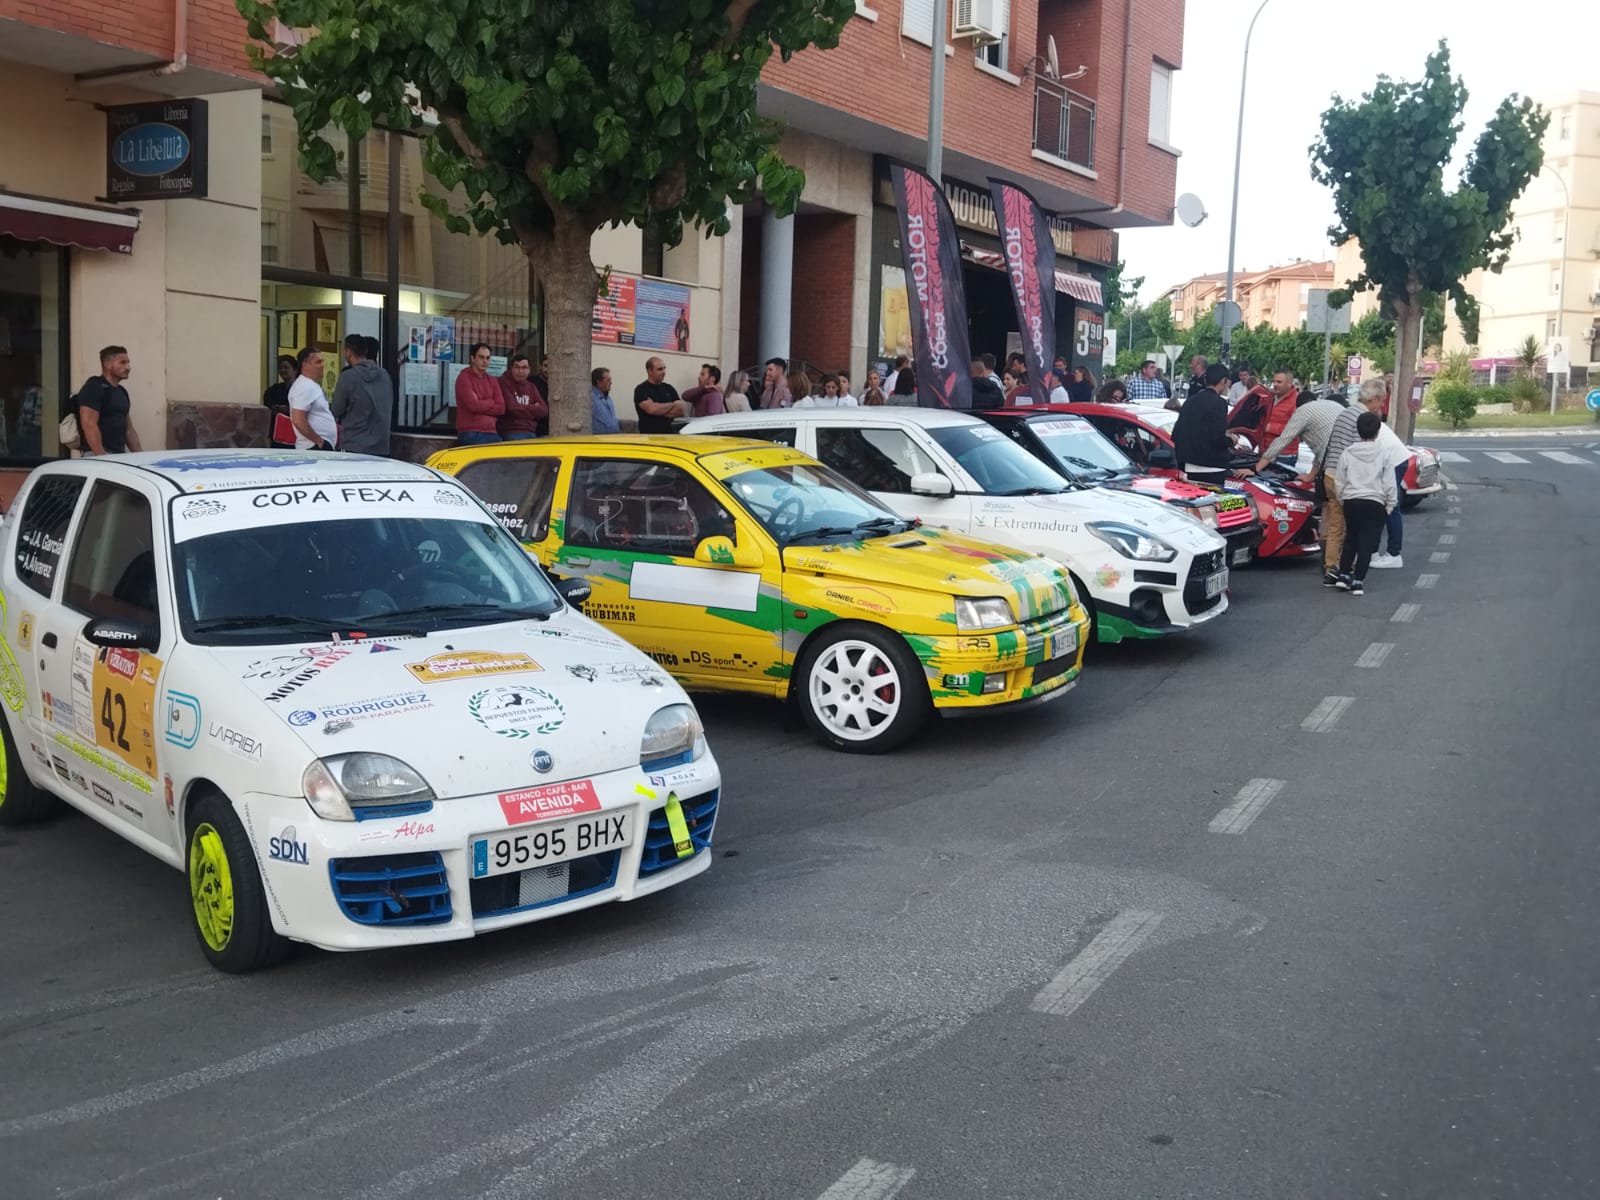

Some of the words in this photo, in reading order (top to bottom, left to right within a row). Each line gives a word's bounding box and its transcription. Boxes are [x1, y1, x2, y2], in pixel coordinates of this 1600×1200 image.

[120, 139, 134, 163] La
[252, 488, 331, 509] COPA
[342, 488, 414, 504] FEXA
[994, 515, 1079, 534] Extremadura
[825, 589, 855, 603] DANIEL
[585, 601, 636, 611] Repuestos
[585, 608, 636, 622] RUBIMAR
[93, 629, 137, 640] ABARTH
[690, 650, 711, 665] DS
[713, 656, 735, 668] sport
[265, 667, 321, 702] MOTOS
[321, 693, 432, 718] RODRIGUEZ
[370, 709, 402, 719] PARA
[403, 702, 435, 713] AGUA
[484, 709, 528, 721] REPUESTOS
[101, 687, 130, 752] 42
[508, 716, 527, 724] SINCE
[209, 721, 264, 759] LARRIBA
[505, 790, 541, 803] ESTANCO
[571, 782, 588, 792] BAR
[519, 791, 585, 814] AVENIDA
[393, 821, 436, 839] Alpa
[269, 836, 307, 863] SDN
[495, 828, 567, 868] 9595
[577, 814, 626, 851] BHX
